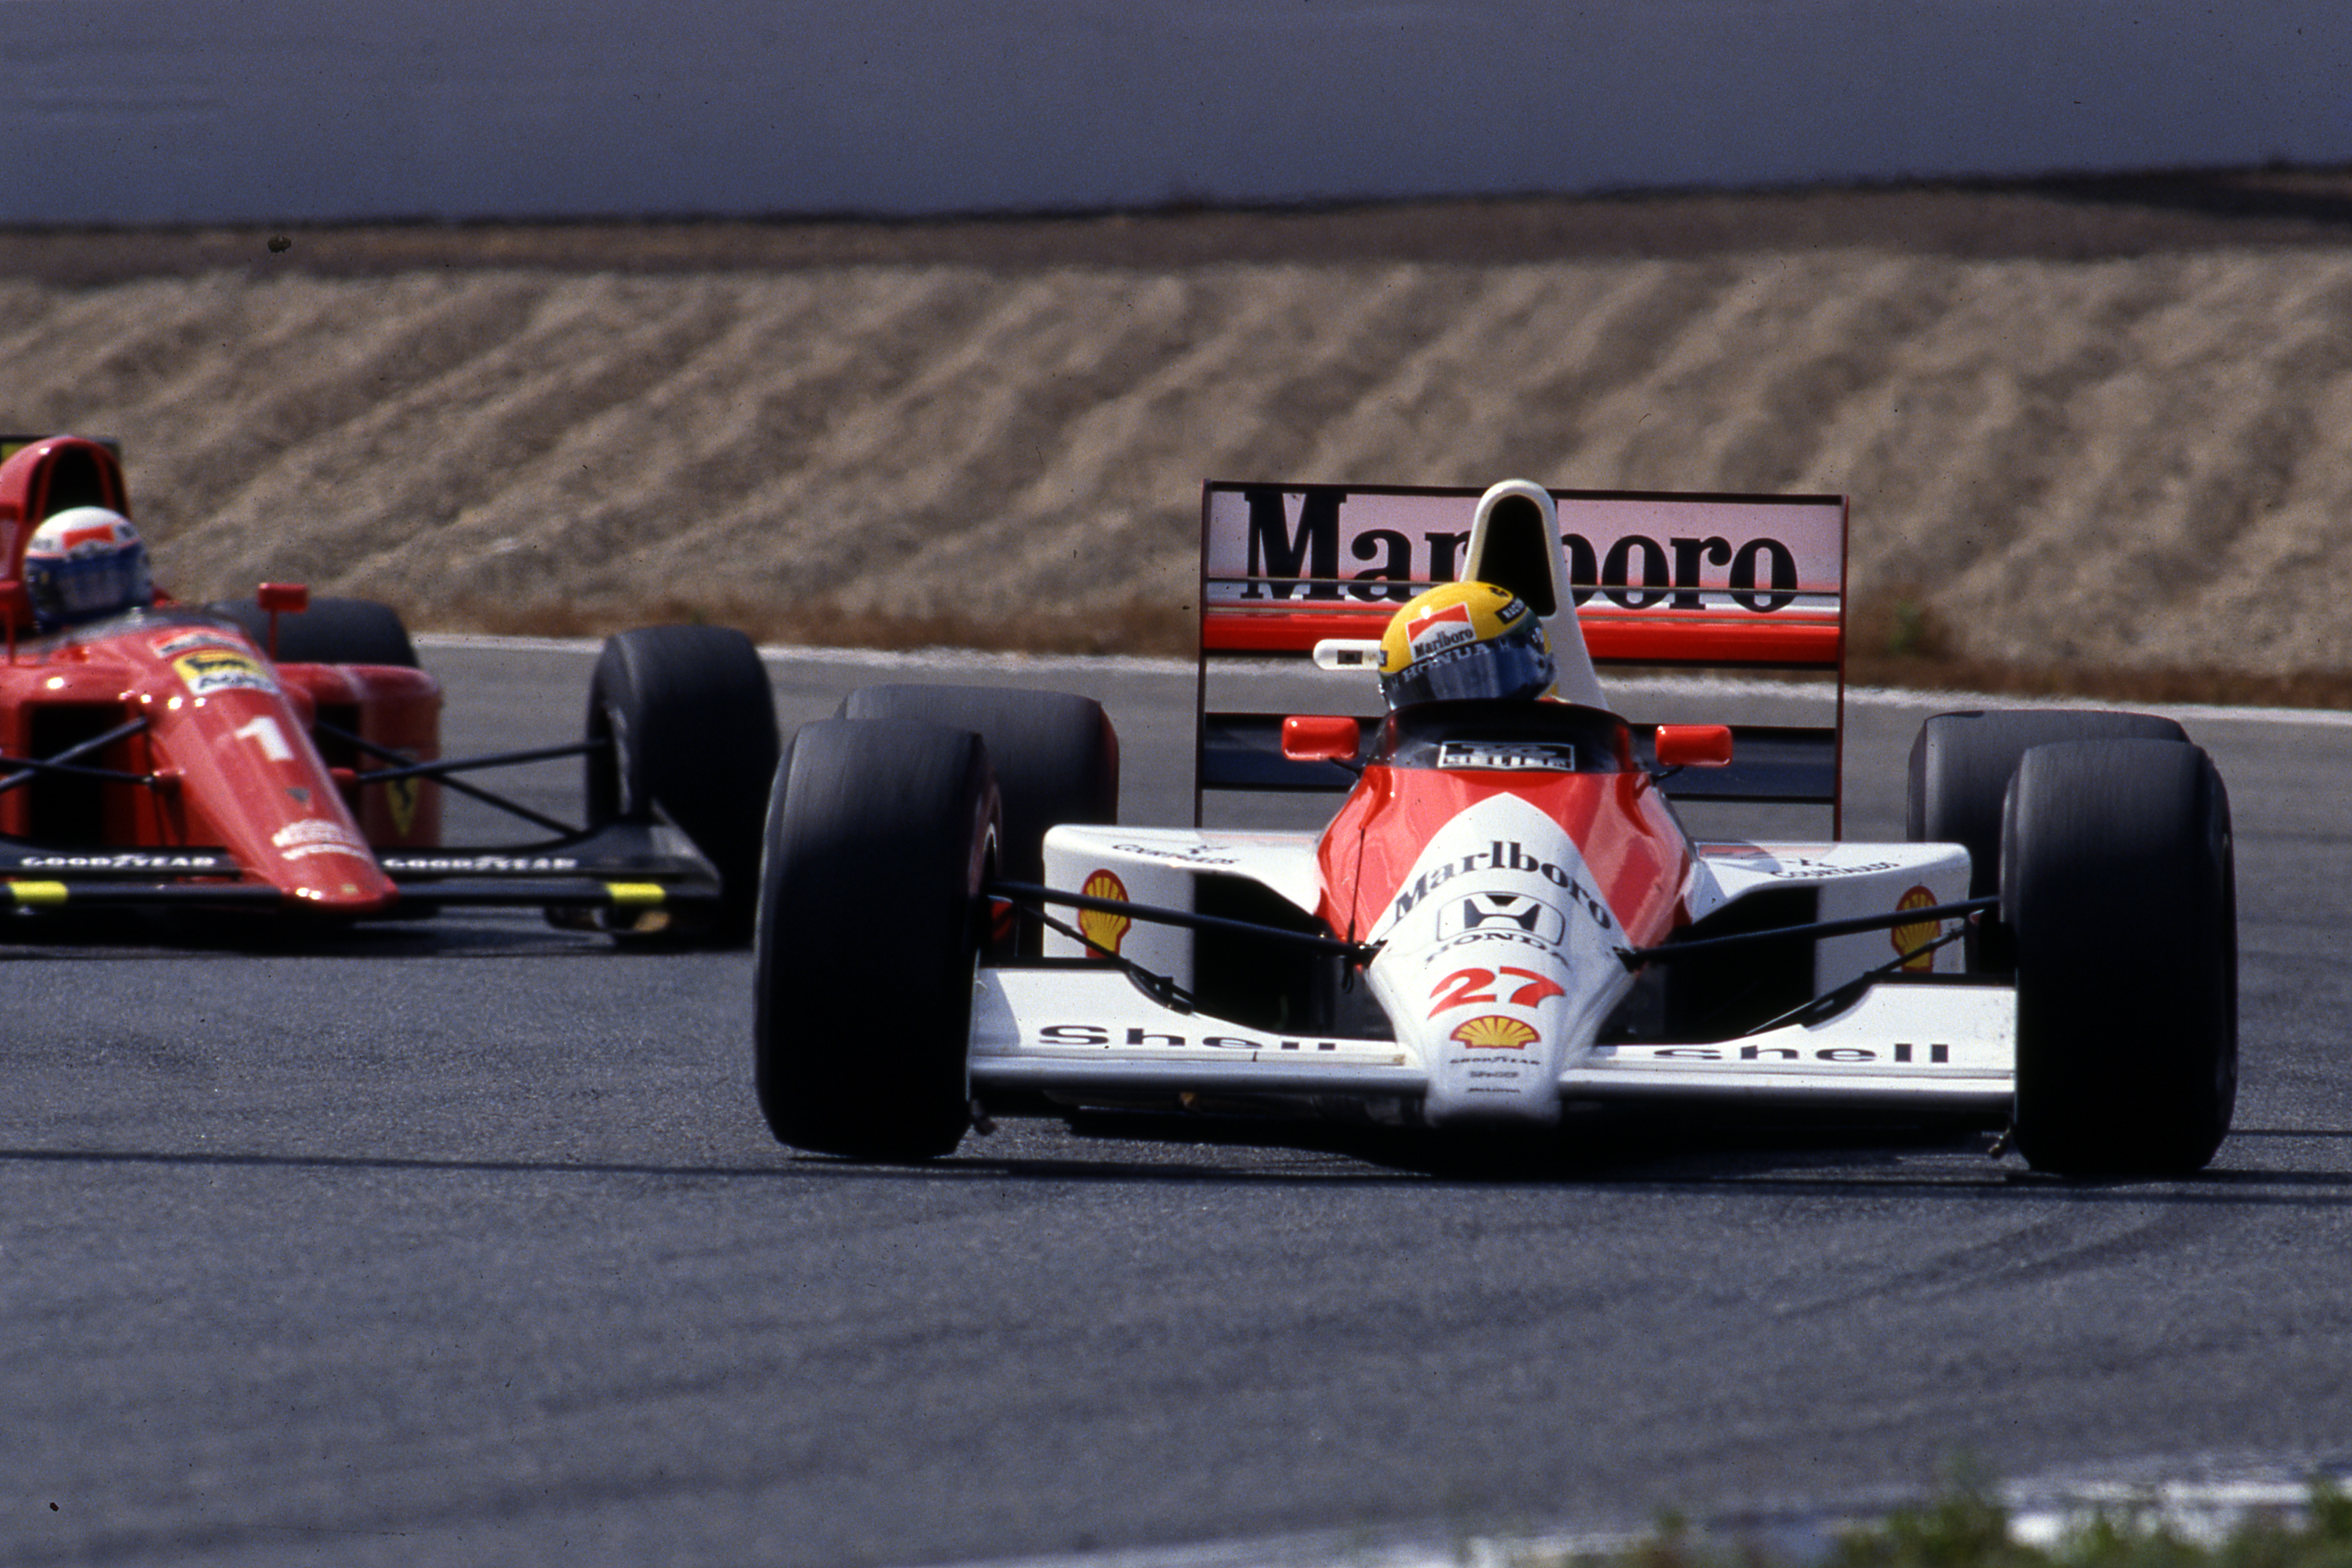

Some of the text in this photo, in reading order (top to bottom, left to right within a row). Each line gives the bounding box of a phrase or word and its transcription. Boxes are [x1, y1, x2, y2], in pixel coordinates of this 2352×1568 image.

[1241, 491, 1798, 612] Maroro
[1414, 628, 1473, 659] Marlboro
[235, 716, 294, 761] 1
[1395, 841, 1611, 929] Marlboro
[1427, 966, 1565, 1021] 27
